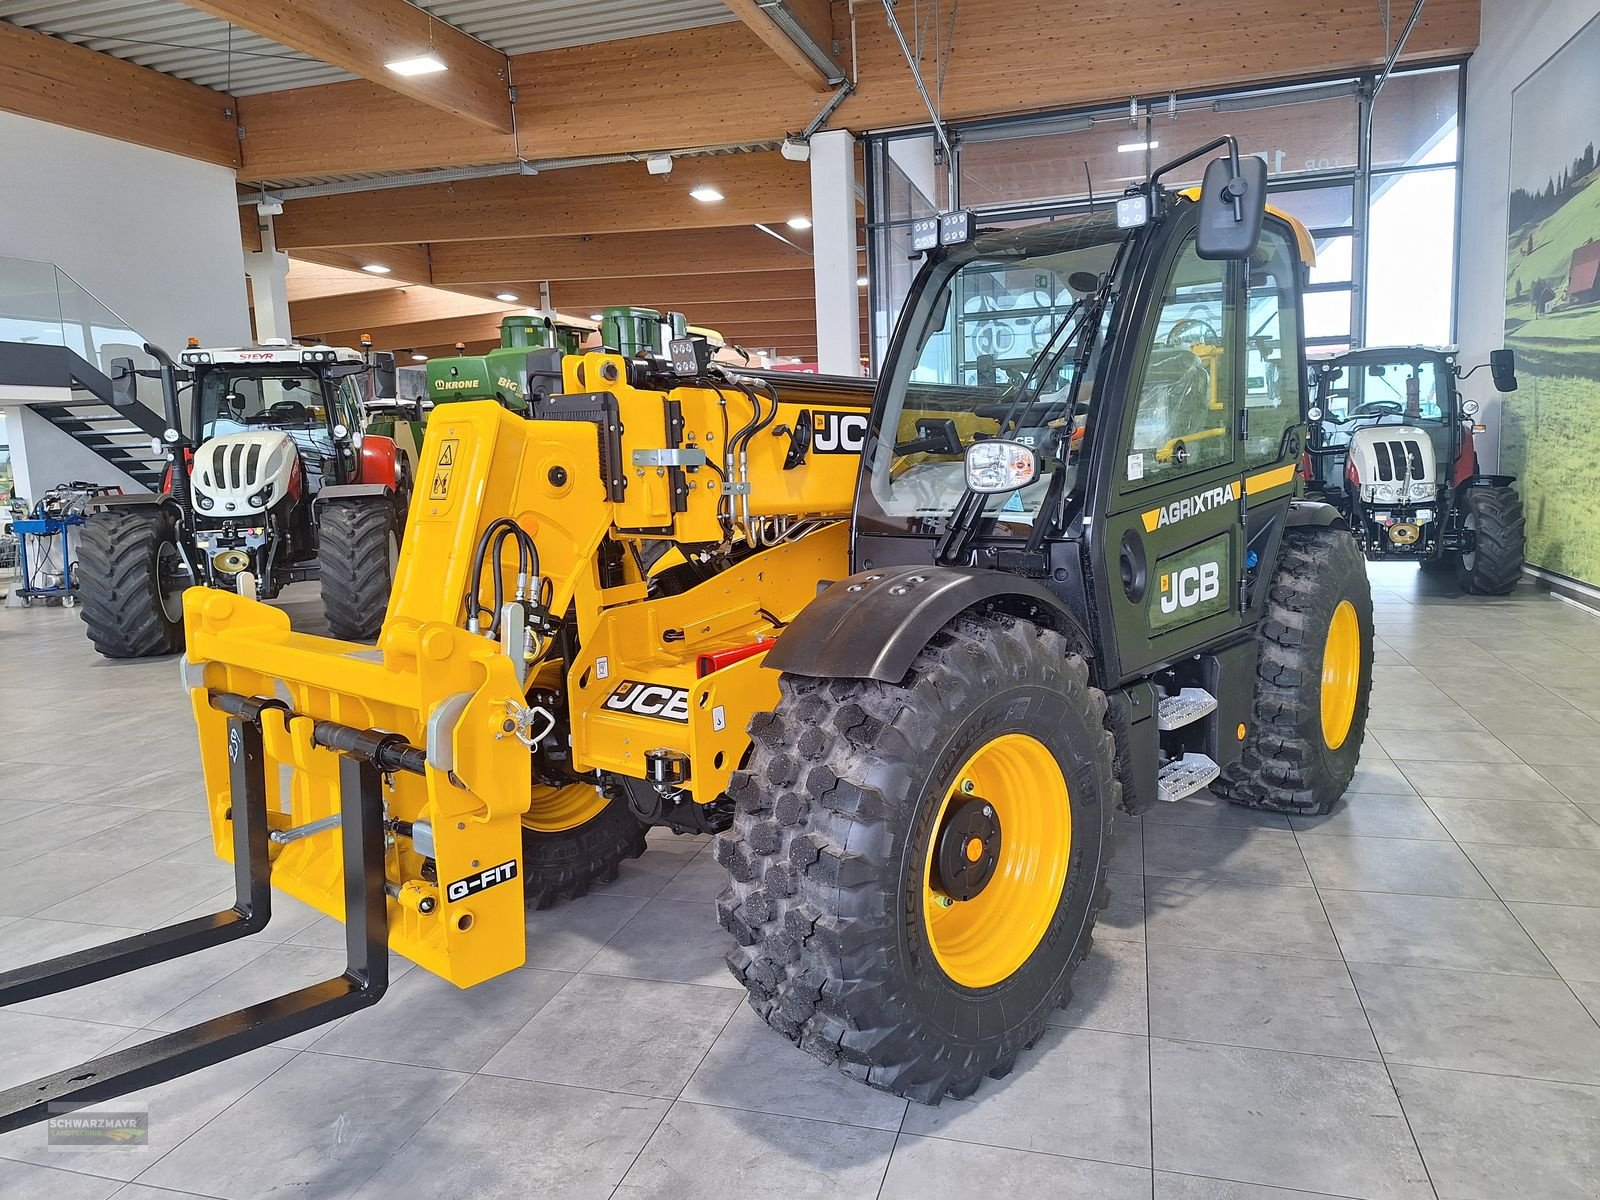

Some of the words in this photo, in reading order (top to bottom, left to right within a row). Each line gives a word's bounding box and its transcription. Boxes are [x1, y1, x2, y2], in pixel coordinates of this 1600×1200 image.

[240, 352, 274, 360] STEYR
[445, 379, 480, 390] KRONE
[815, 415, 868, 451] JC
[1014, 436, 1035, 445] CB
[1156, 482, 1233, 528] AGRIXTRA
[1161, 561, 1220, 614] JCB
[449, 860, 516, 900] Q-FIT
